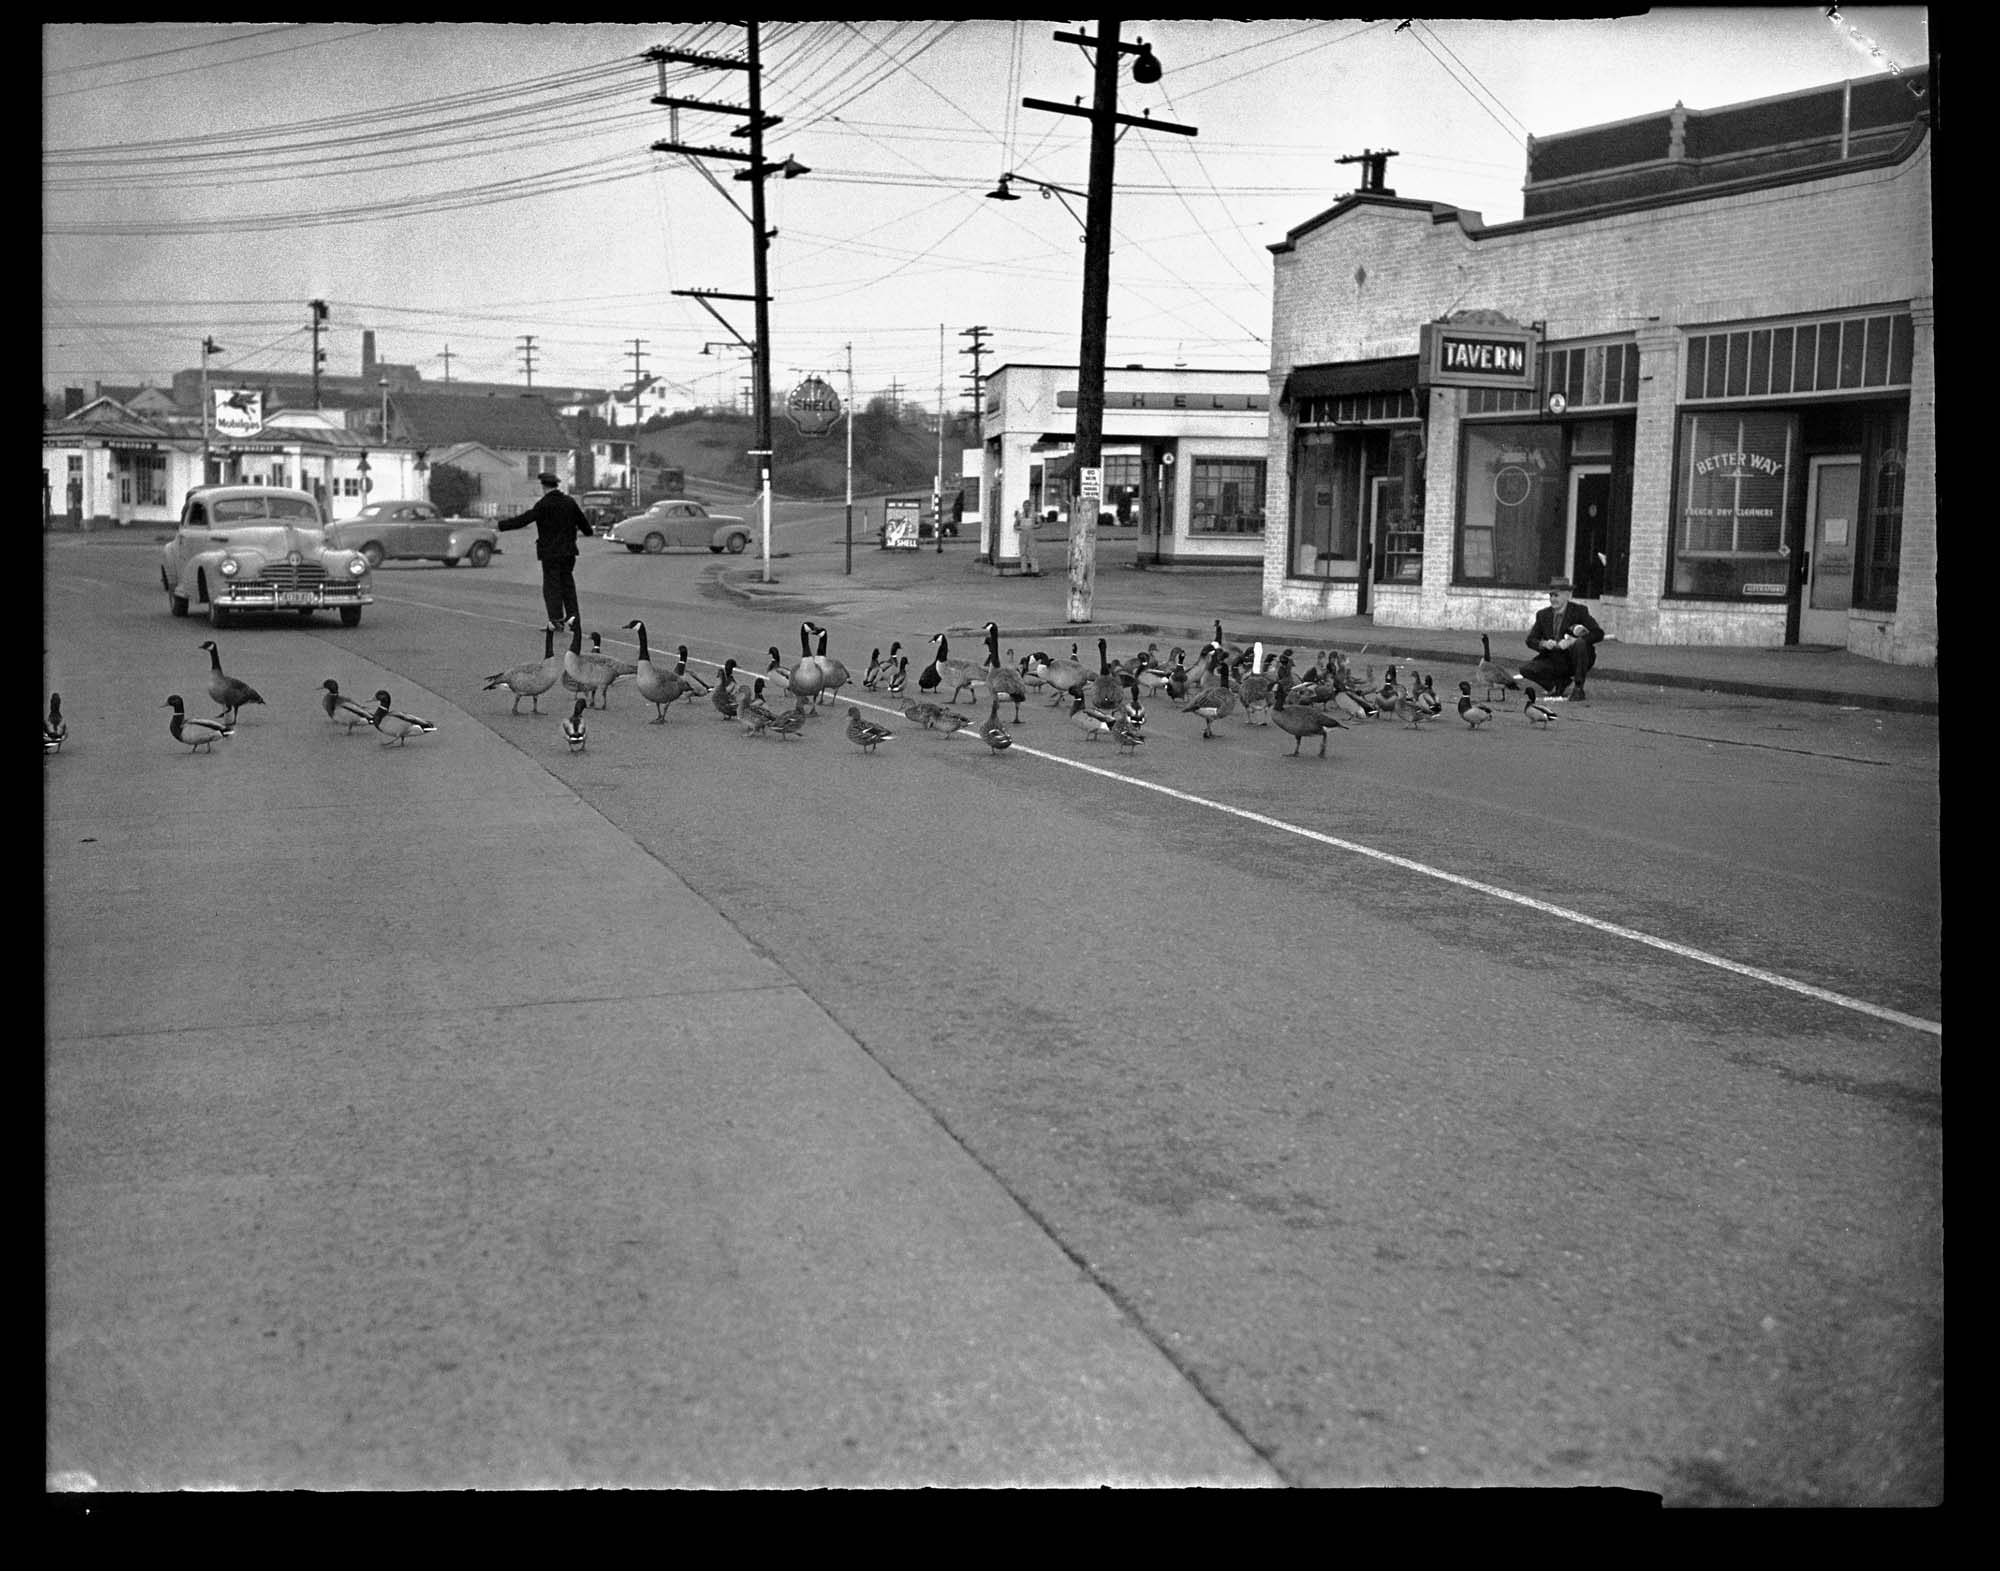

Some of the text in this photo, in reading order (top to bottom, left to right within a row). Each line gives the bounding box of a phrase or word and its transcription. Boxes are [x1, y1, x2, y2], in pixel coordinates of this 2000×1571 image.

[1443, 342, 1523, 370] TAVERN
[791, 399, 837, 412] SHELL
[1102, 394, 1258, 409] HELL
[218, 418, 260, 432] Mobilgas
[1696, 452, 1783, 476] BETTER WAY
[1717, 508, 1732, 516] DRY
